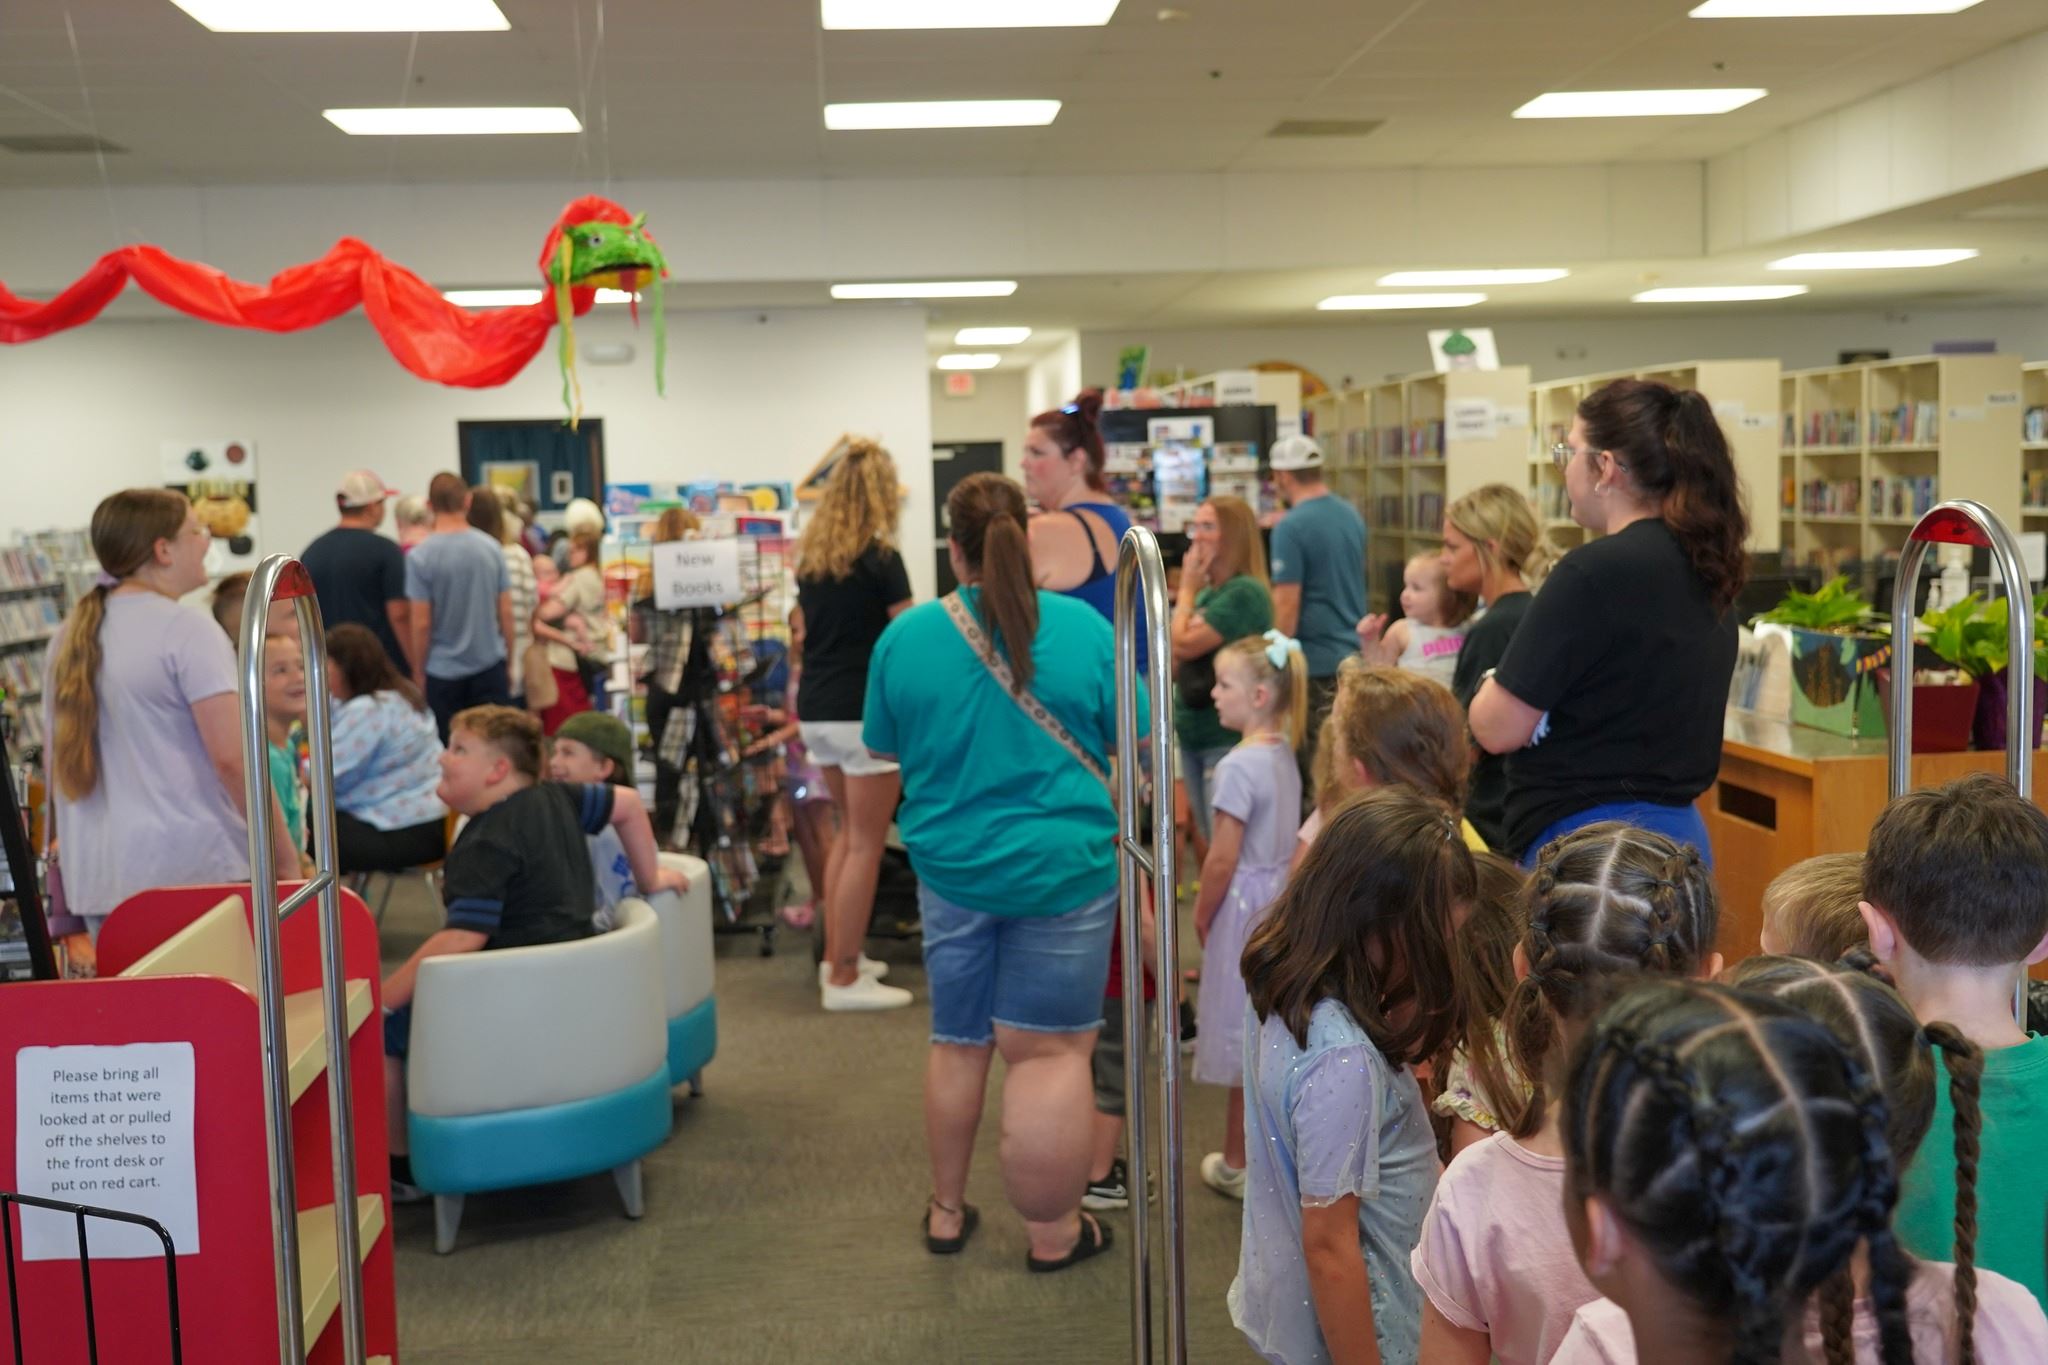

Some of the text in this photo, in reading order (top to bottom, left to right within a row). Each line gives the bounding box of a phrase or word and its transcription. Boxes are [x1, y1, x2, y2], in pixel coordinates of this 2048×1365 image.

[676, 552, 715, 567] New
[673, 580, 723, 596] Books
[53, 1067, 159, 1082] Please bring all
[51, 1090, 161, 1104] items that were
[40, 1110, 171, 1126] looked at or pulled
[45, 1133, 166, 1148] off the shelves to
[47, 1154, 165, 1170] the front desk or
[51, 1177, 161, 1193] put on red cart.
